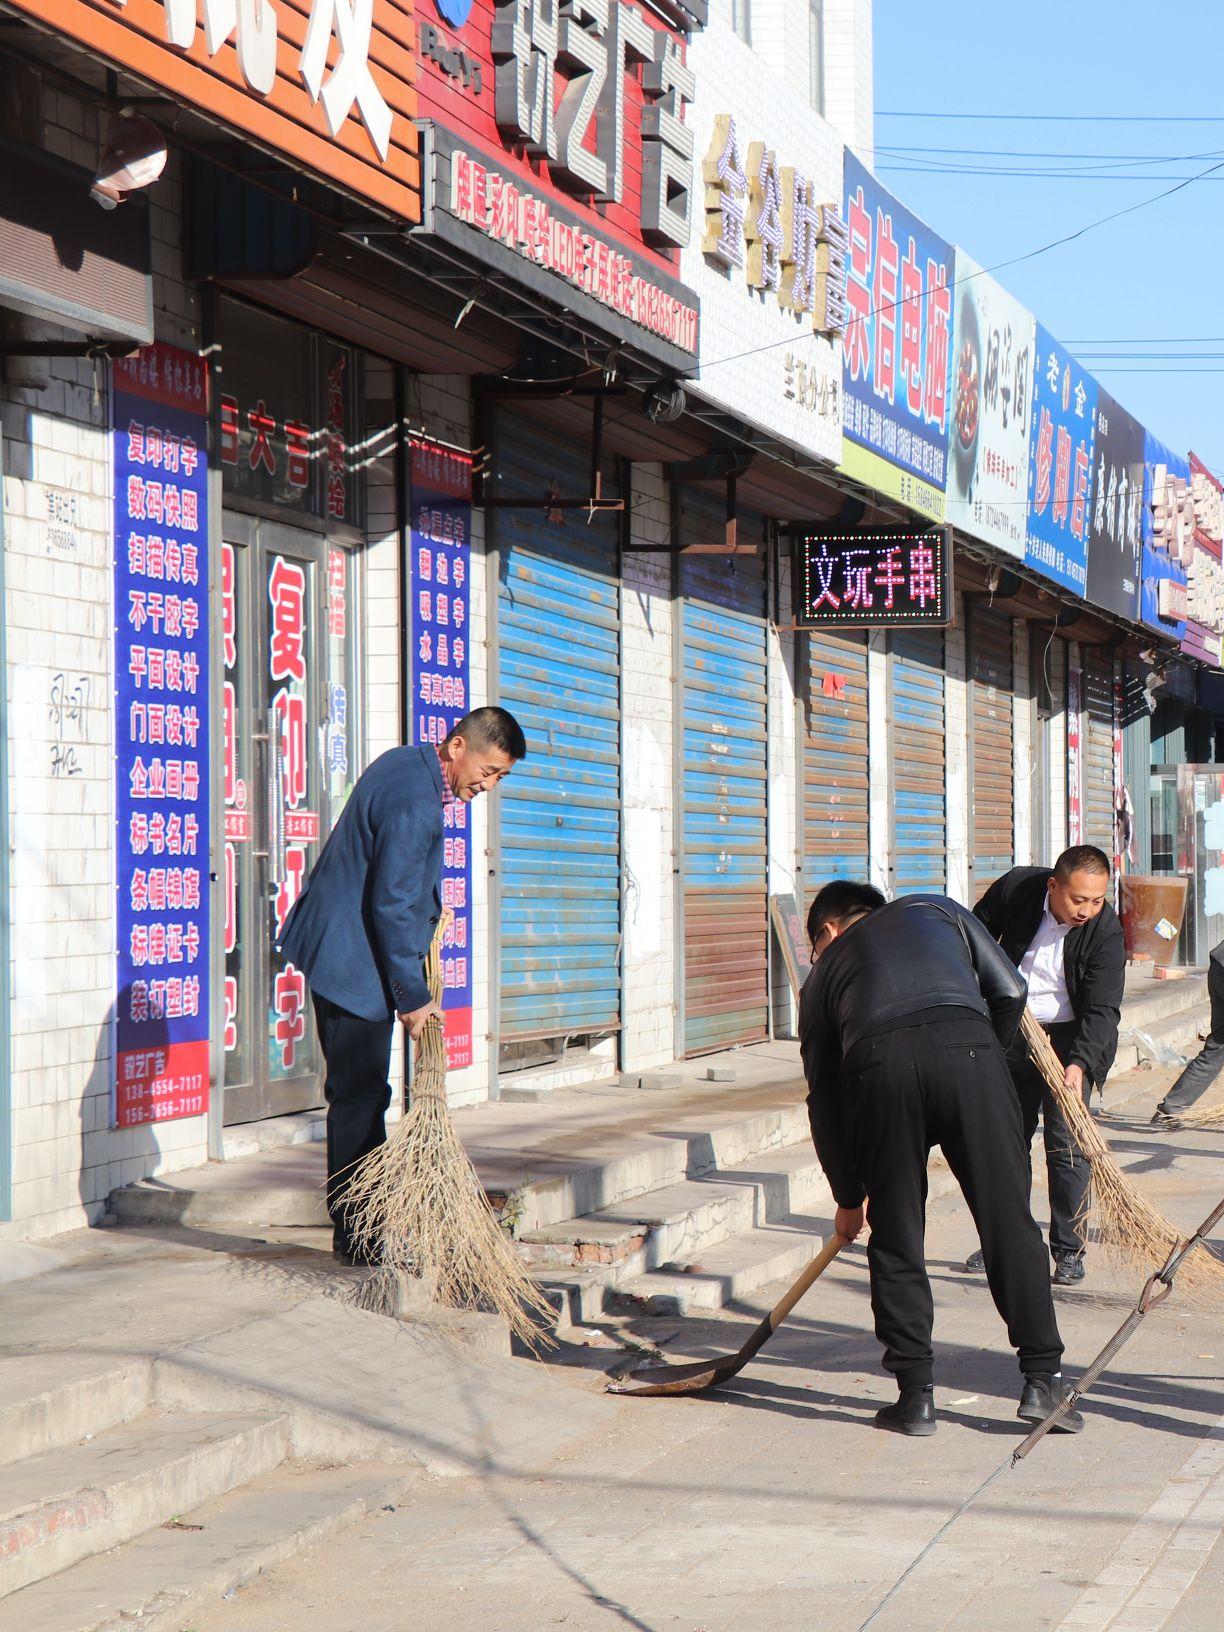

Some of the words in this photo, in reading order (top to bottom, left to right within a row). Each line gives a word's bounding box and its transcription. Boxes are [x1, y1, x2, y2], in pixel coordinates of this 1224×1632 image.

[842, 185, 953, 437] 宗信电脑
[1074, 379, 1087, 418] 金
[127, 419, 198, 477] 复印打字
[1034, 403, 1089, 542] 修脚店
[128, 474, 198, 532] 数码快照
[128, 531, 199, 585] 扫描传真
[809, 539, 938, 610] 文玩手串
[128, 589, 199, 640] 不干胶字
[419, 590, 465, 628] 吸塑字
[129, 644, 199, 695] 平面设计
[419, 630, 465, 668] 水晶字
[419, 672, 465, 709] 写真喷绘
[130, 699, 199, 749] 门面设计
[328, 683, 347, 774] 传真
[130, 755, 199, 803] 企业画册
[130, 812, 199, 856] 标书名片
[130, 866, 200, 911] 条幅锦旗
[130, 921, 199, 967] 标牌证卡
[130, 973, 200, 1023] 装订塑封
[124, 1049, 166, 1081] 锐艺广告
[125, 1074, 202, 1101] 138-4554-7117
[125, 1096, 202, 1124] 156-3656-7117
